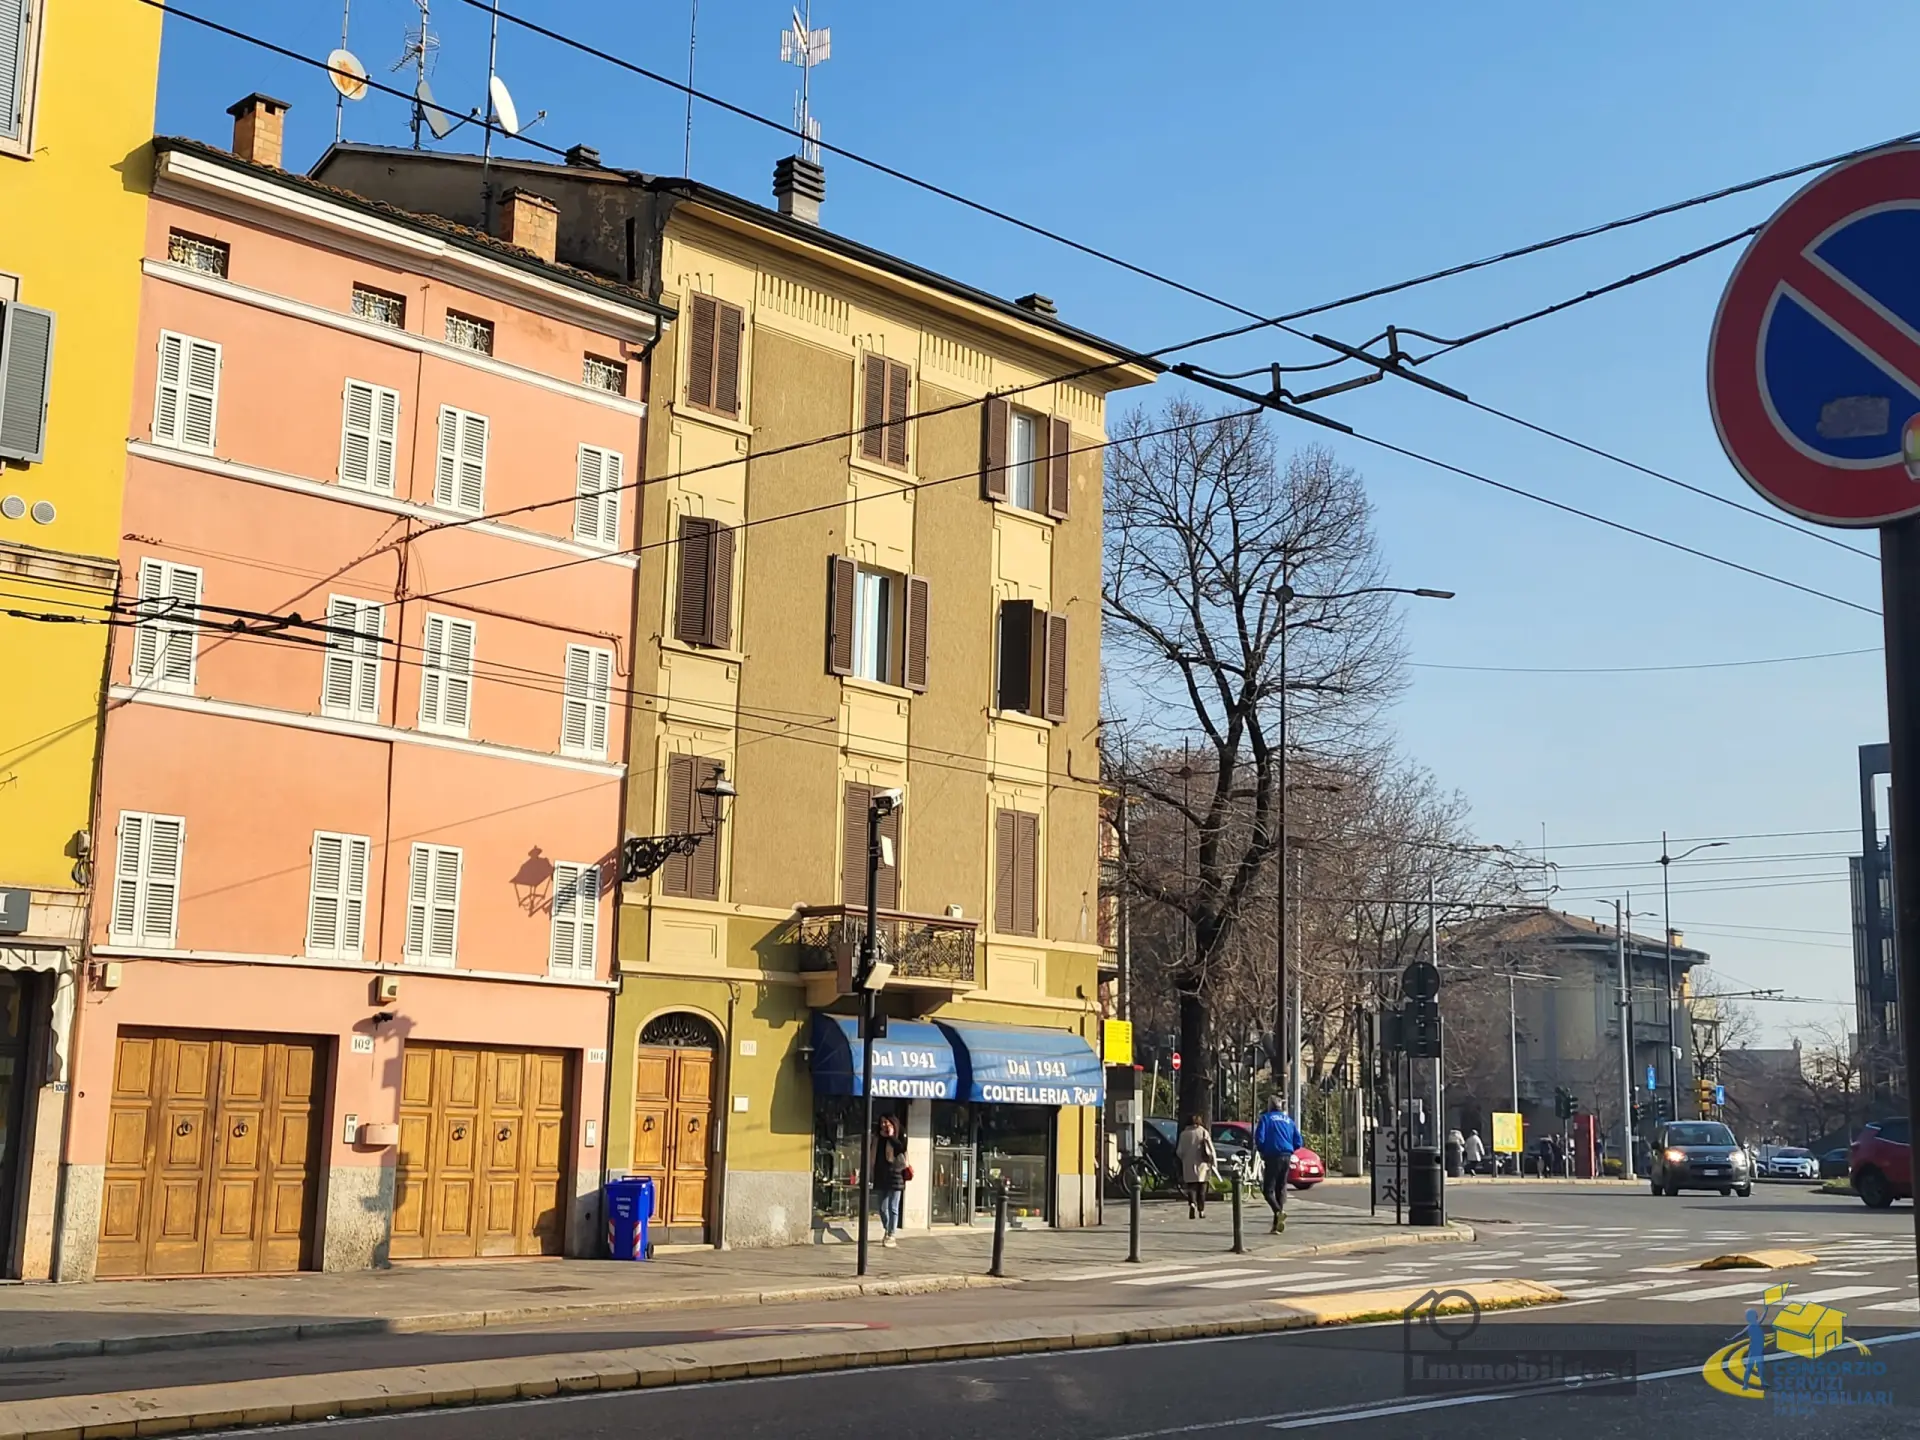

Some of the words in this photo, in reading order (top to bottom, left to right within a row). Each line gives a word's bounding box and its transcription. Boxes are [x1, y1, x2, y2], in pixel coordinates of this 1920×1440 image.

[353, 1038, 371, 1051] 102
[872, 1049, 895, 1067] Dal
[901, 1051, 937, 1069] 1941
[1007, 1059, 1031, 1076] Dal
[1036, 1060, 1068, 1077] 1941
[869, 1078, 947, 1098] ARROTINO
[982, 1084, 1072, 1104] COLTELLERIA
